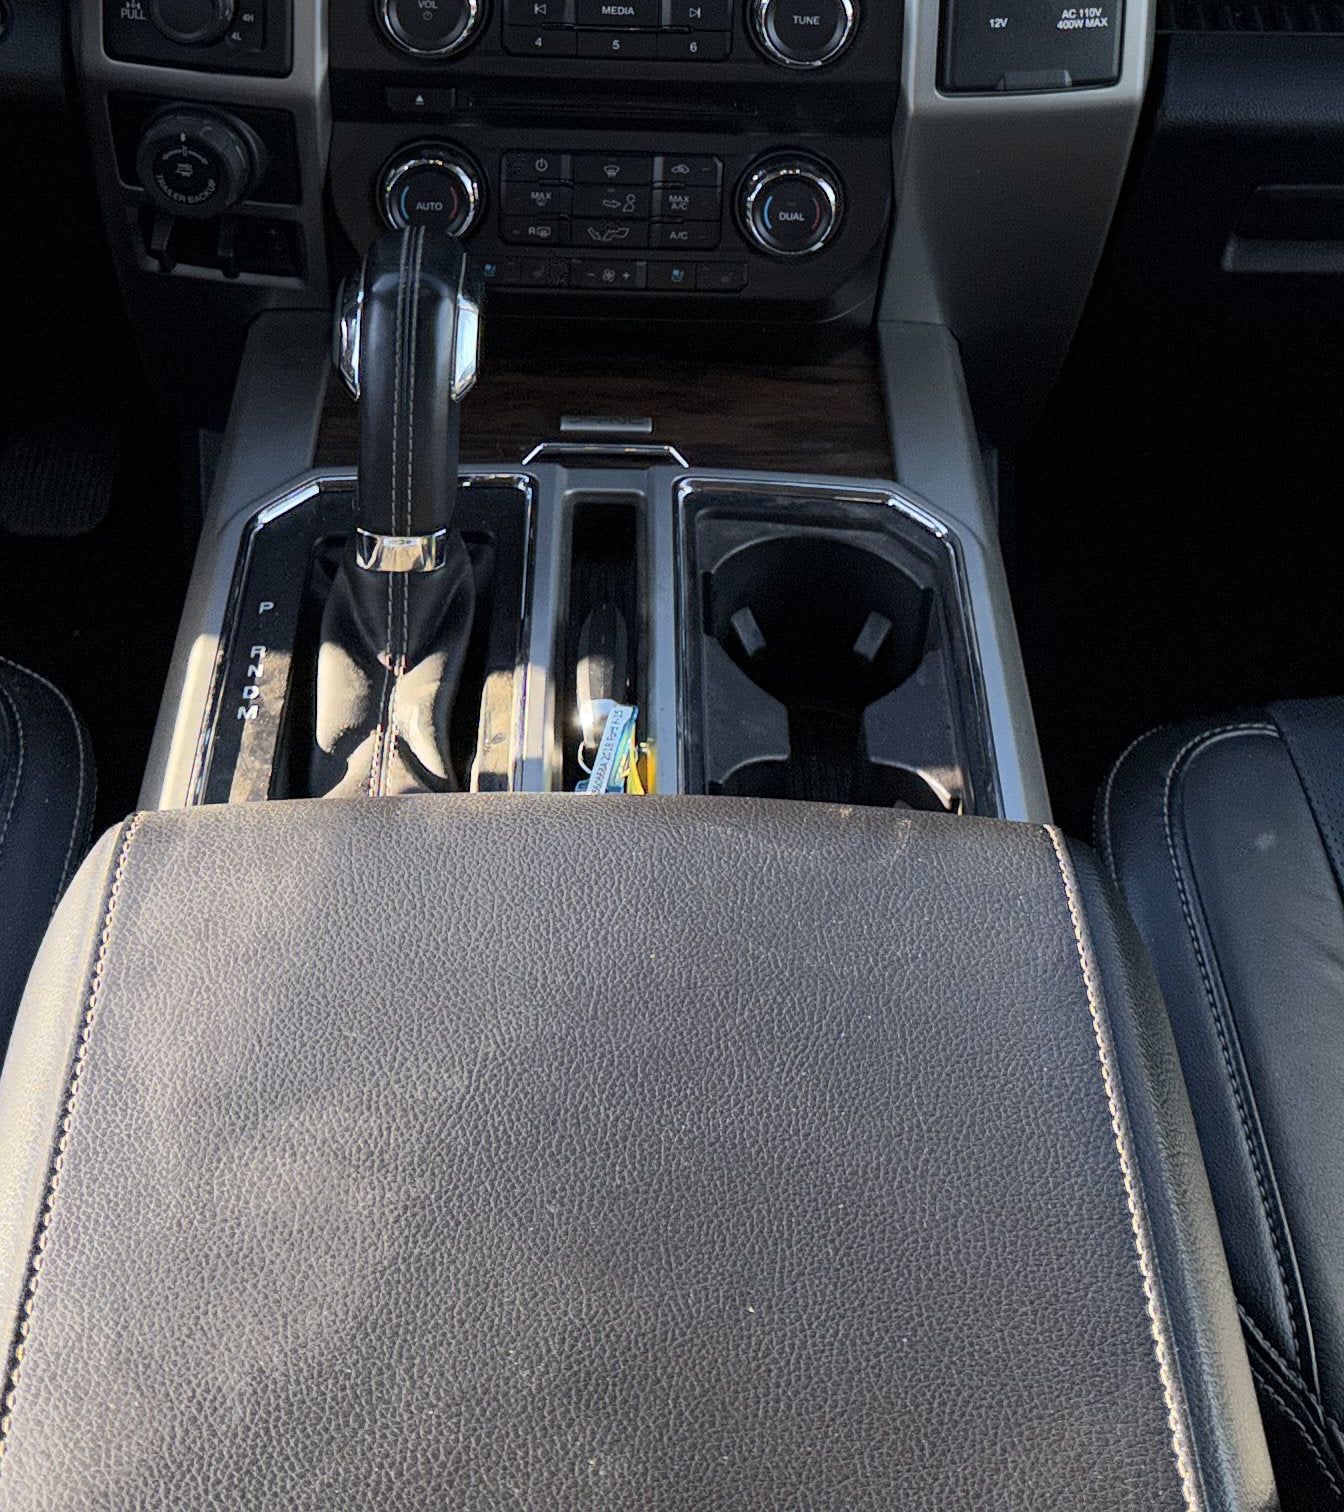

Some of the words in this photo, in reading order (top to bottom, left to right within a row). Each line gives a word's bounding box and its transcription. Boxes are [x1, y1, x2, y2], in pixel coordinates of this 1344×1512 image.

[418, 0, 438, 8] VOL
[120, 8, 146, 20] PULL
[601, 6, 635, 15] MEDIA
[1062, 9, 1077, 19] AC
[1079, 8, 1103, 18] 110V
[242, 13, 254, 23] 4H
[792, 15, 821, 25] TUNE
[989, 18, 1008, 28] 12V
[1056, 19, 1084, 29] 400W
[1085, 17, 1108, 28] MAX
[231, 32, 242, 41] 4L
[535, 38, 542, 47] 4
[612, 40, 620, 50] 5
[690, 42, 698, 52] 6
[155, 174, 187, 203] TRAILER
[187, 178, 216, 204] BACKUP
[531, 192, 551, 200] MAX
[669, 195, 689, 203] MAX
[416, 201, 443, 211] AUTO
[671, 202, 688, 210] A/C
[779, 212, 805, 221] DUAL
[669, 231, 689, 240] A/C
[258, 601, 274, 614] P
[250, 645, 266, 659] R
[247, 663, 264, 678] N
[242, 685, 260, 700] D
[237, 705, 258, 720] M
